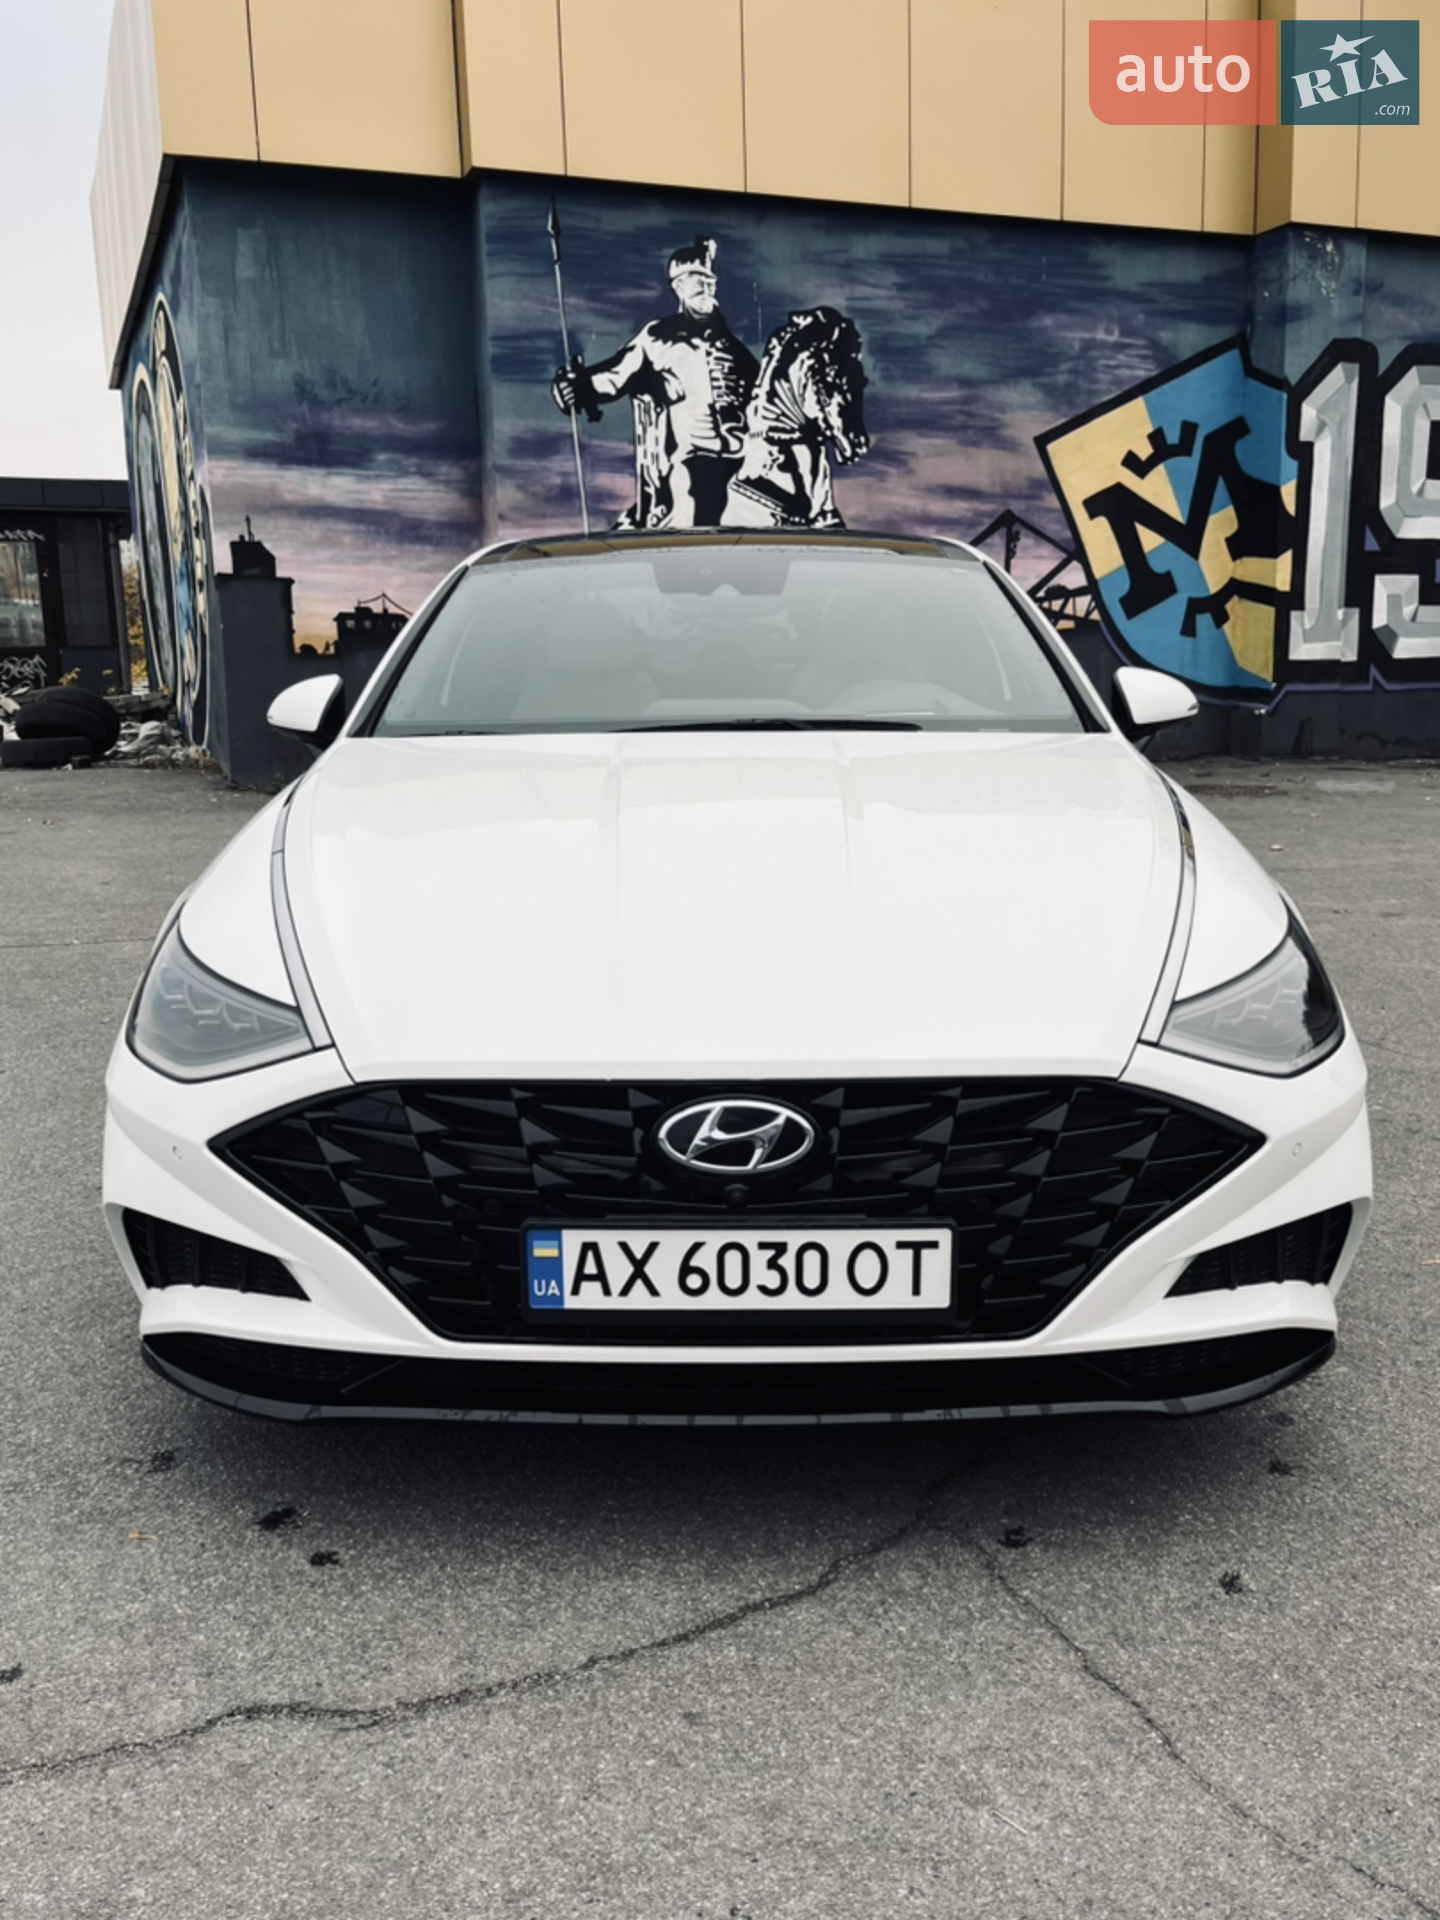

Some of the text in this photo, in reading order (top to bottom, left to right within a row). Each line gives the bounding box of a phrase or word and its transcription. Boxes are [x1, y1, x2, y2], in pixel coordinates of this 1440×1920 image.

[570, 1240, 939, 1297] AX 6030 OT
[533, 1279, 560, 1297] UA
